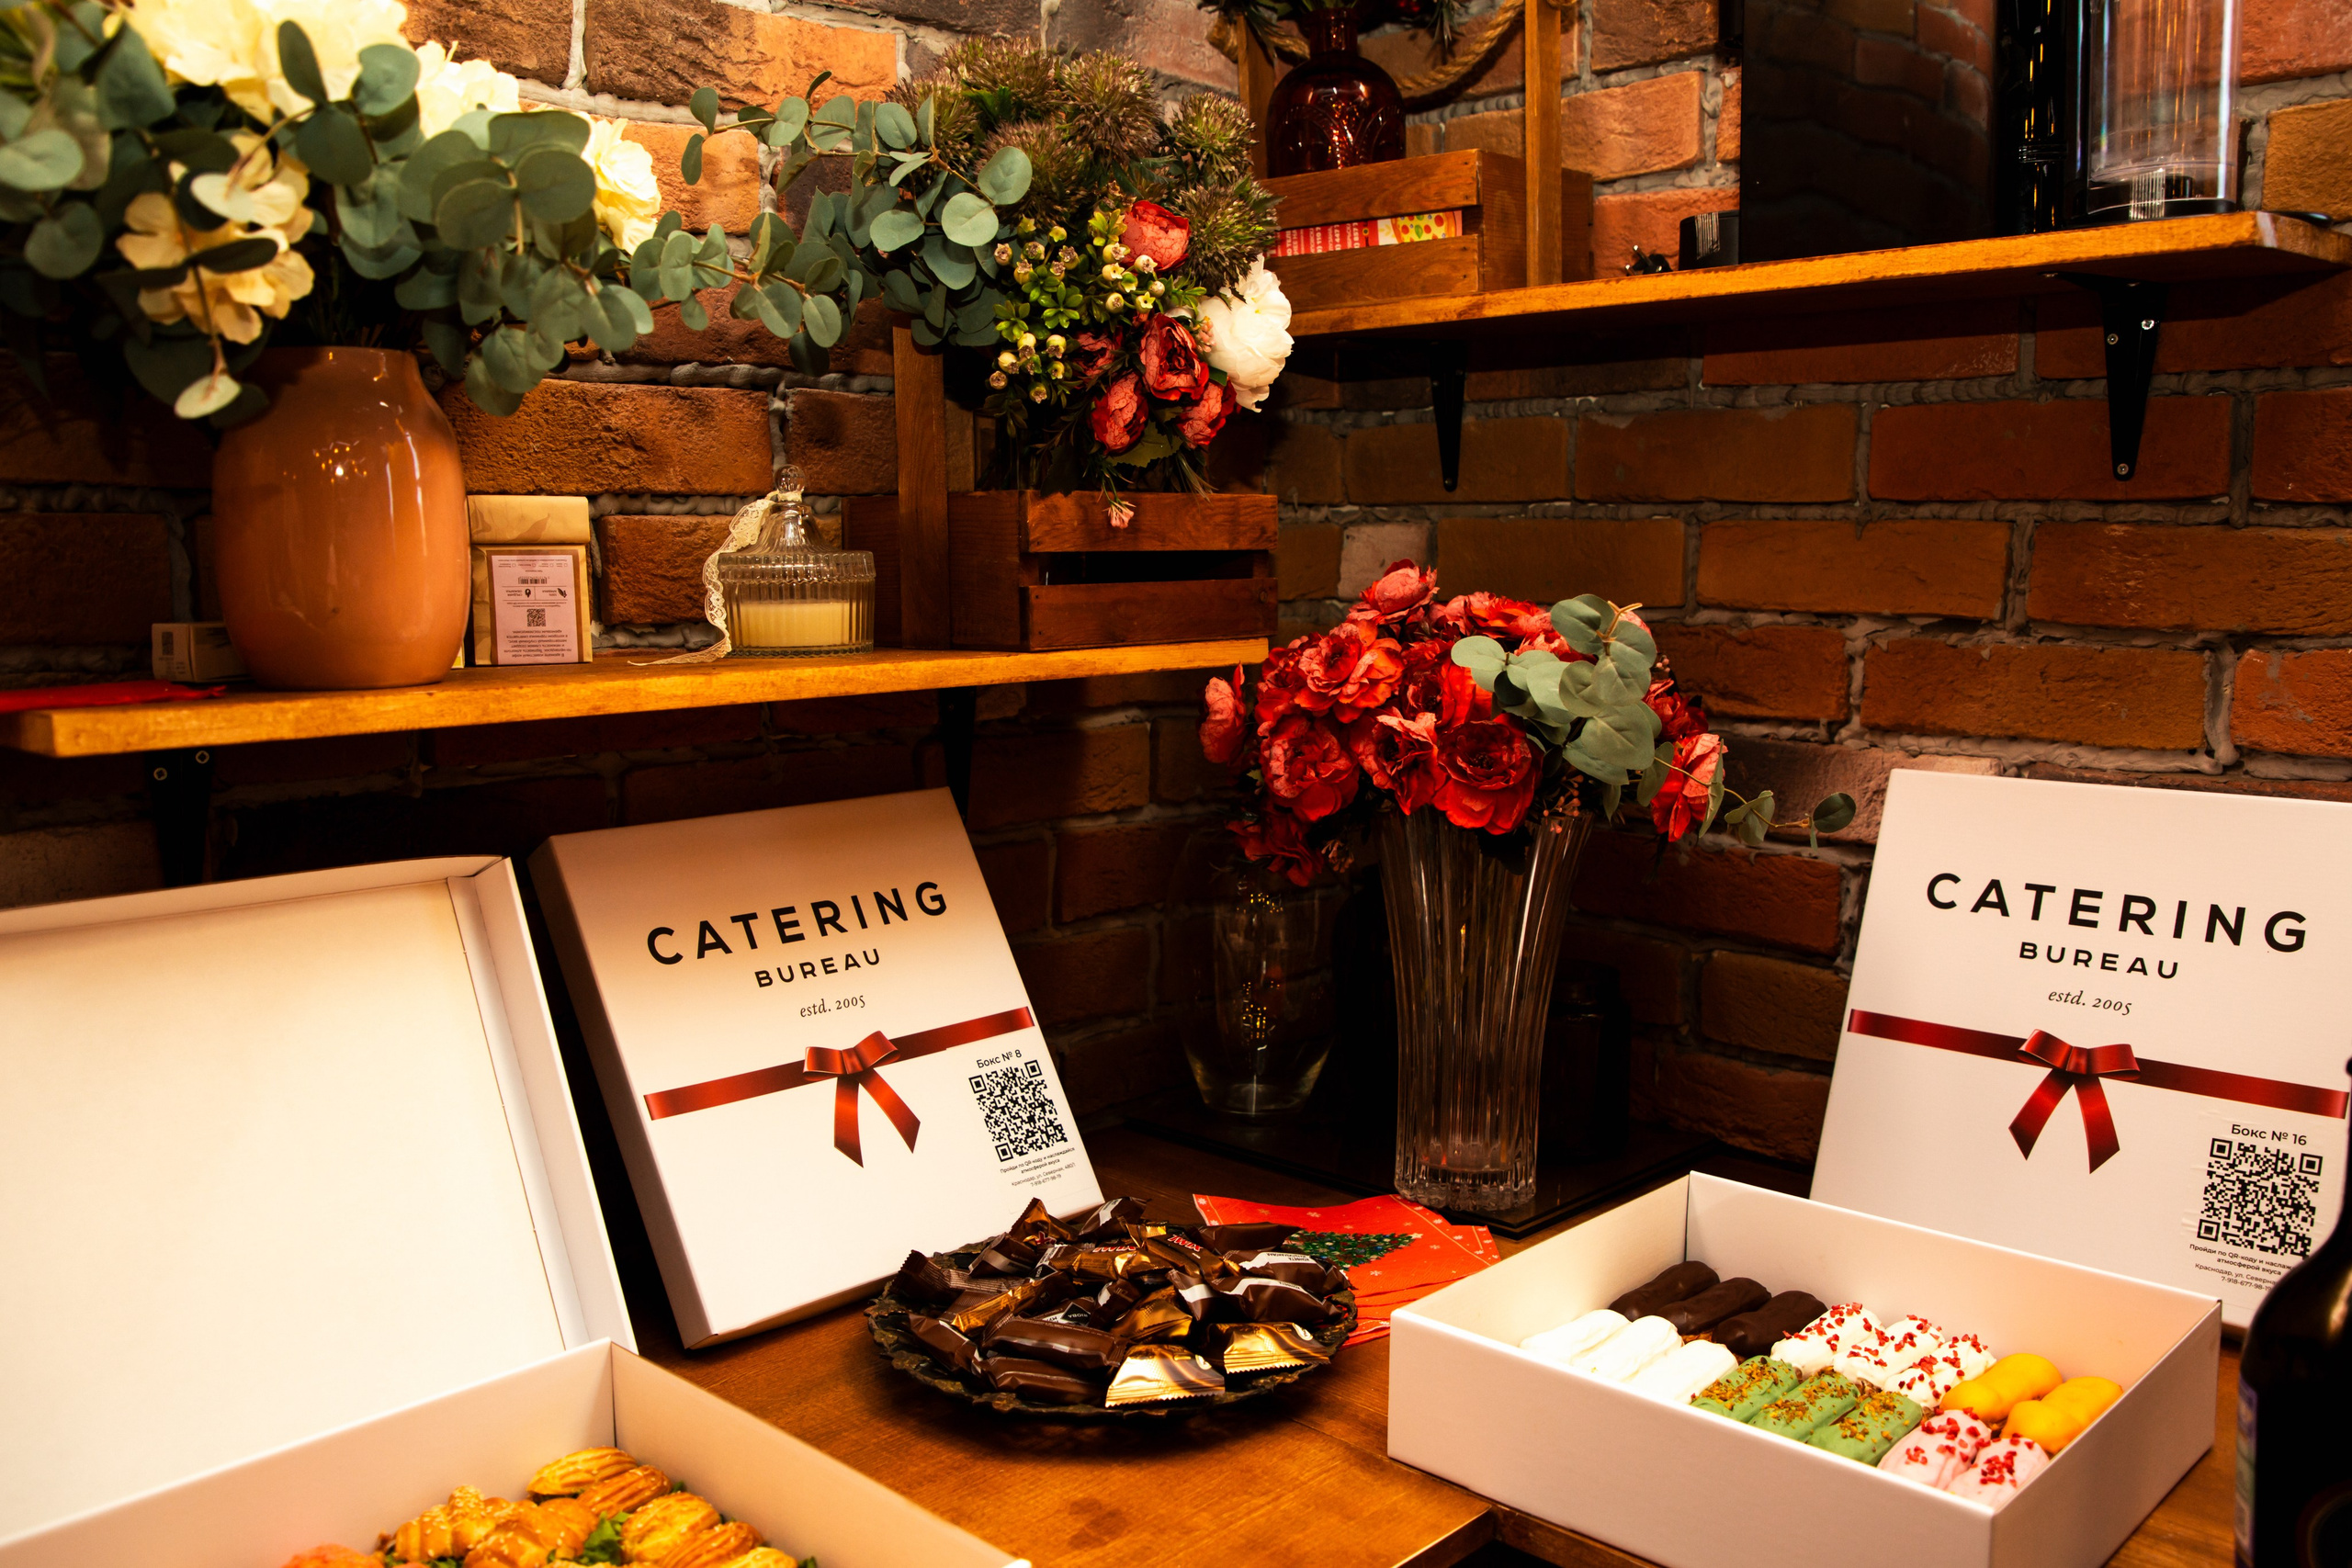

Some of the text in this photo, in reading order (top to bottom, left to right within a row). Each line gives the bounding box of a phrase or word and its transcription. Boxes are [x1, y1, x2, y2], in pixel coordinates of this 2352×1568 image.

[647, 881, 947, 965] CATERING
[1927, 873, 2307, 953] CATERING
[754, 948, 880, 987] BUREAU
[2018, 942, 2178, 979] BUREAU
[799, 995, 865, 1018] estd. 2005
[2048, 989, 2132, 1016] estd. 2005
[976, 1056, 1001, 1068] Бокс
[1014, 1049, 1022, 1058] 8
[2231, 1123, 2267, 1139] Бокс
[2292, 1133, 2307, 1146] 16
[1168, 1234, 1204, 1252] TWIX
[2189, 1244, 2217, 1254] Пройди
[2228, 1252, 2257, 1263] QR-коду
[2265, 1260, 2294, 1269] наслаж
[2217, 1258, 2281, 1276] атмосферой вкуса
[2195, 1263, 2233, 1277] Краснодар,
